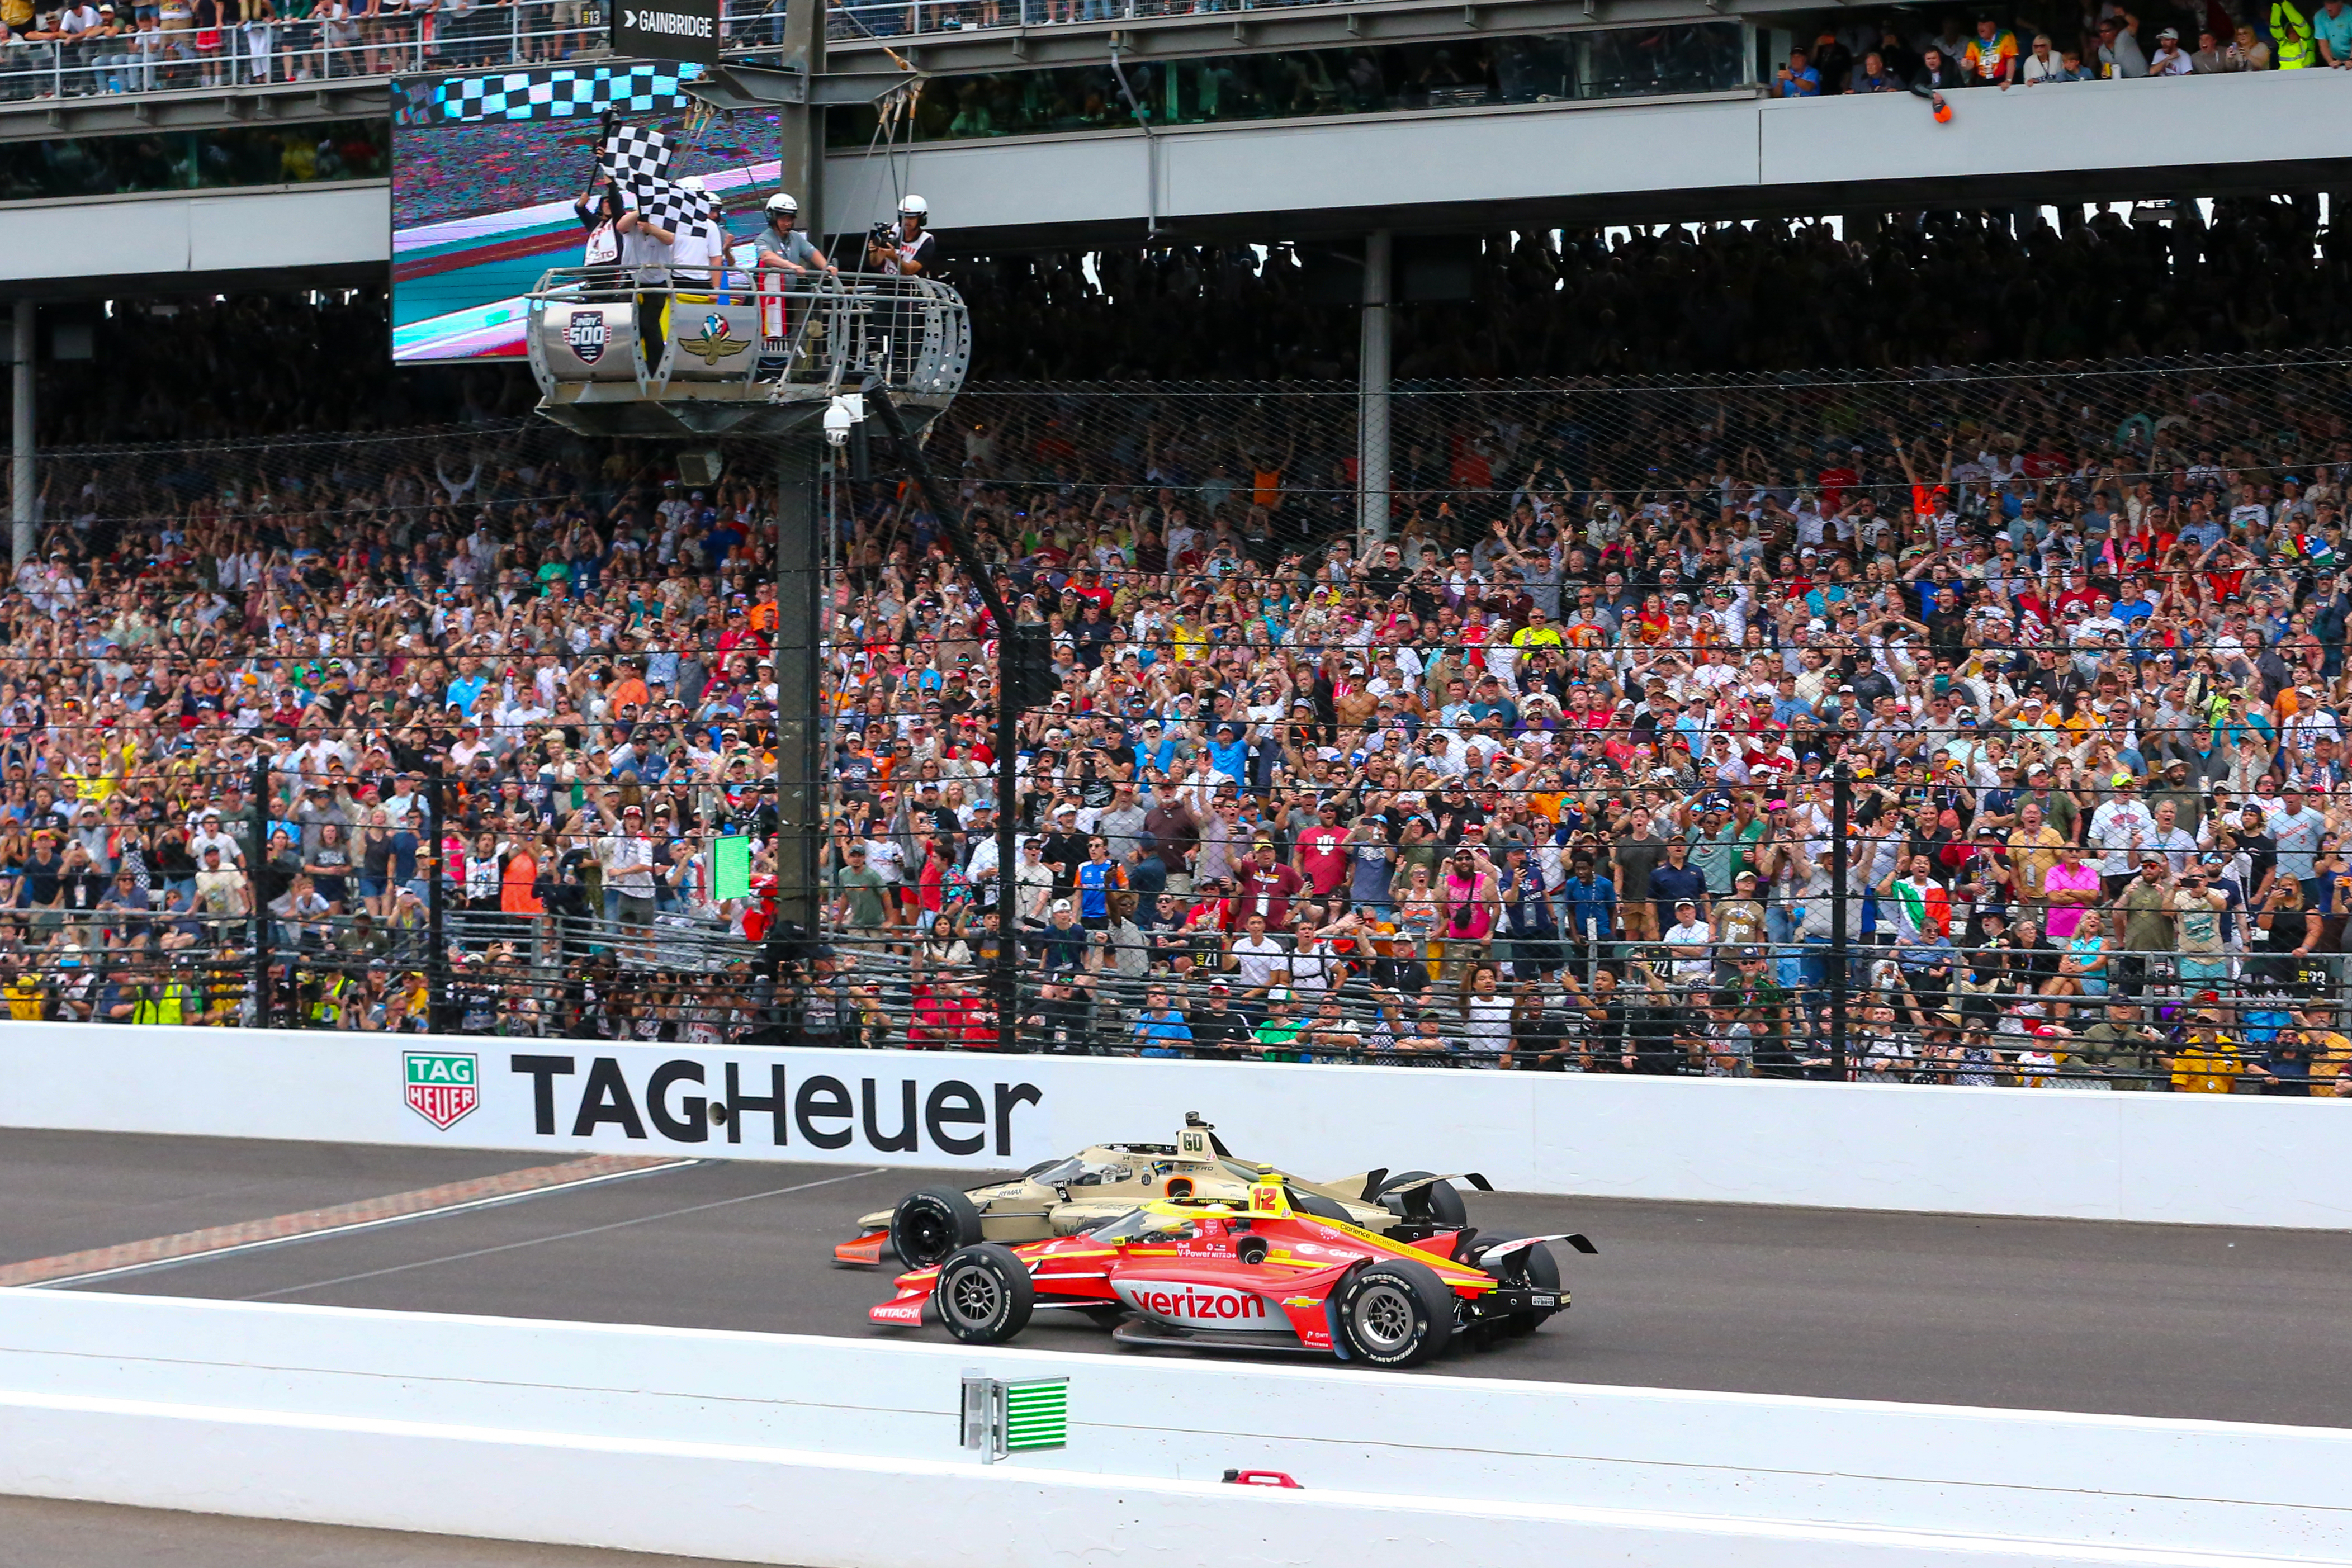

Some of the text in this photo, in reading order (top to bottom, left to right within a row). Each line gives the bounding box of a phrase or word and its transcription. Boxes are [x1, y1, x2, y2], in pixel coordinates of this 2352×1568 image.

[589, 11, 600, 25] 13
[639, 10, 712, 38] GAINBRIDGE
[576, 318, 598, 326] INDY
[569, 326, 605, 345] 500
[410, 1059, 470, 1082] TAG
[410, 1087, 474, 1122] HEUER
[1183, 1133, 1203, 1151] 60
[1253, 1188, 1277, 1210] 12
[1340, 1223, 1370, 1239] Clarience
[1372, 1235, 1414, 1255] TECHNOLOGIES
[1177, 1249, 1210, 1258] V-Power
[873, 1308, 920, 1318] HITACHI
[1130, 1286, 1266, 1319] verizon
[1369, 1339, 1418, 1363] FIREHAWK
